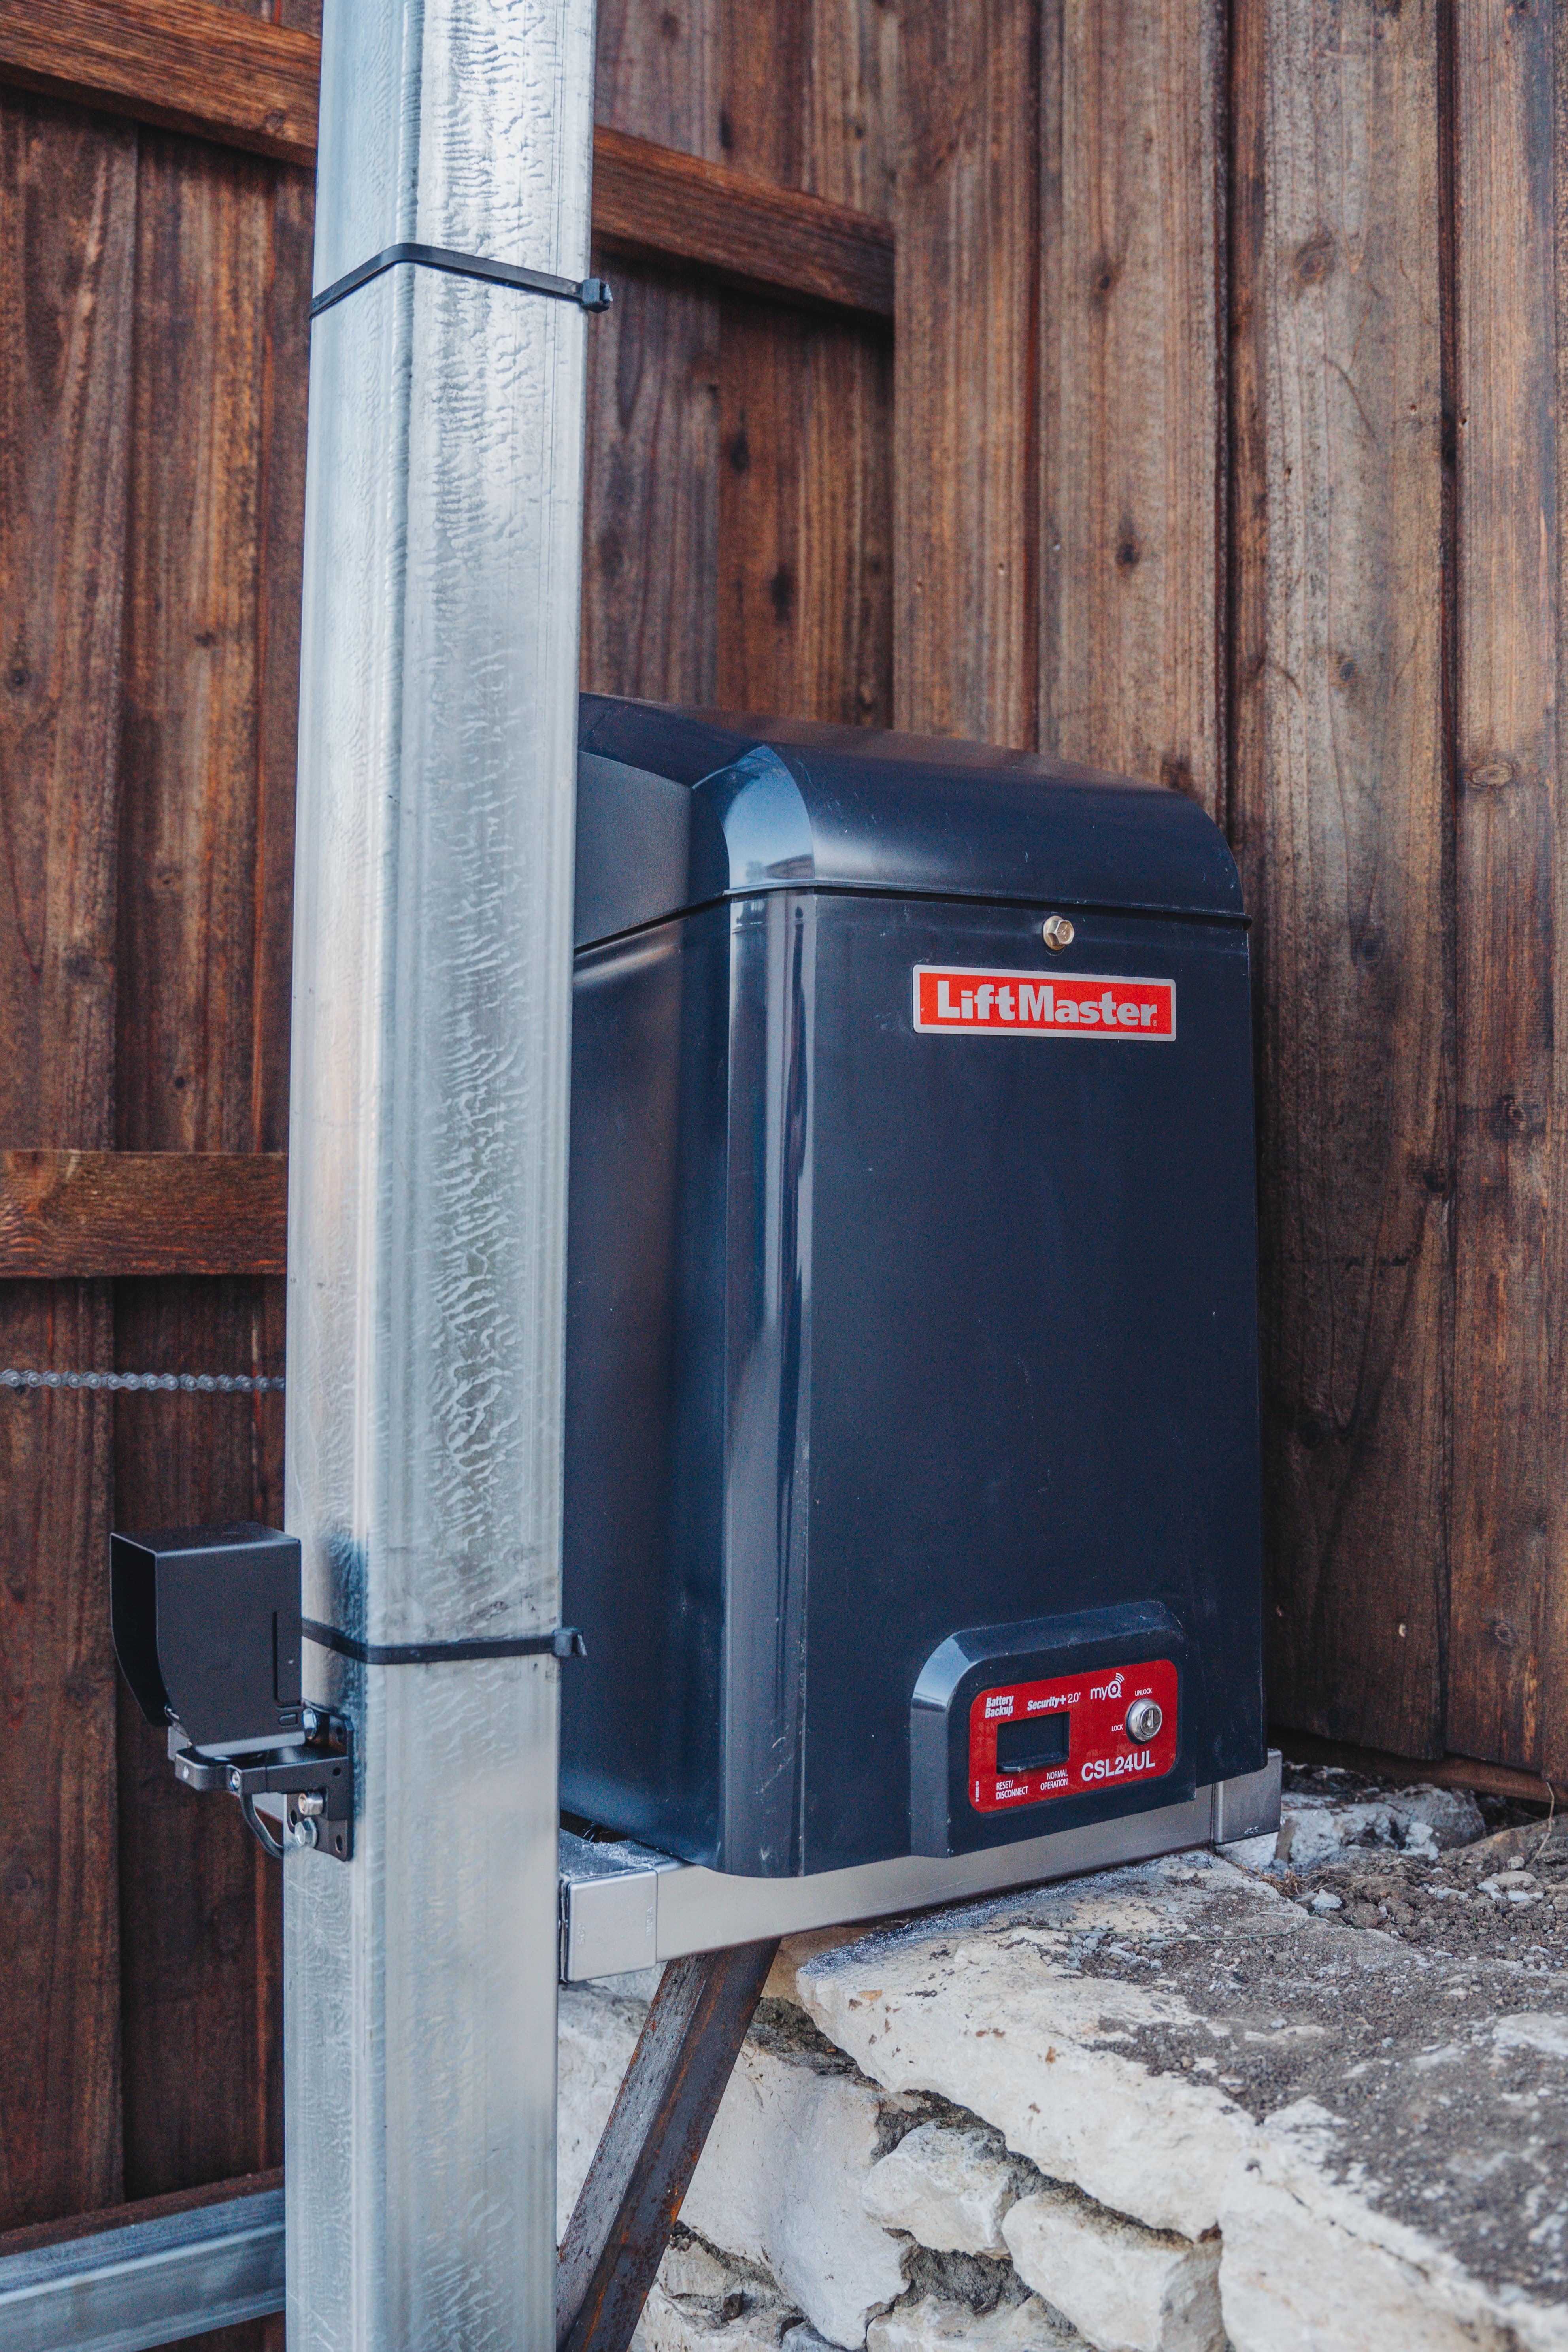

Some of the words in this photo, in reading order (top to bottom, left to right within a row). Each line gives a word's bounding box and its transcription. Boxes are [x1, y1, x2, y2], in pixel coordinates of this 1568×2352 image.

[1090, 1680, 1122, 1701] myQ
[1135, 1688, 1152, 1696] UNLOCK
[986, 1696, 1014, 1708] Battery
[1027, 1695, 1066, 1711] Security+
[985, 1705, 1013, 1718] Backup
[1081, 1750, 1155, 1781] CSL24UL
[1047, 1769, 1068, 1780] NORMAL
[996, 1780, 1013, 1790] RESET/
[1040, 1778, 1068, 1791] OPERATION
[996, 1786, 1028, 1800] DISCONNECT
